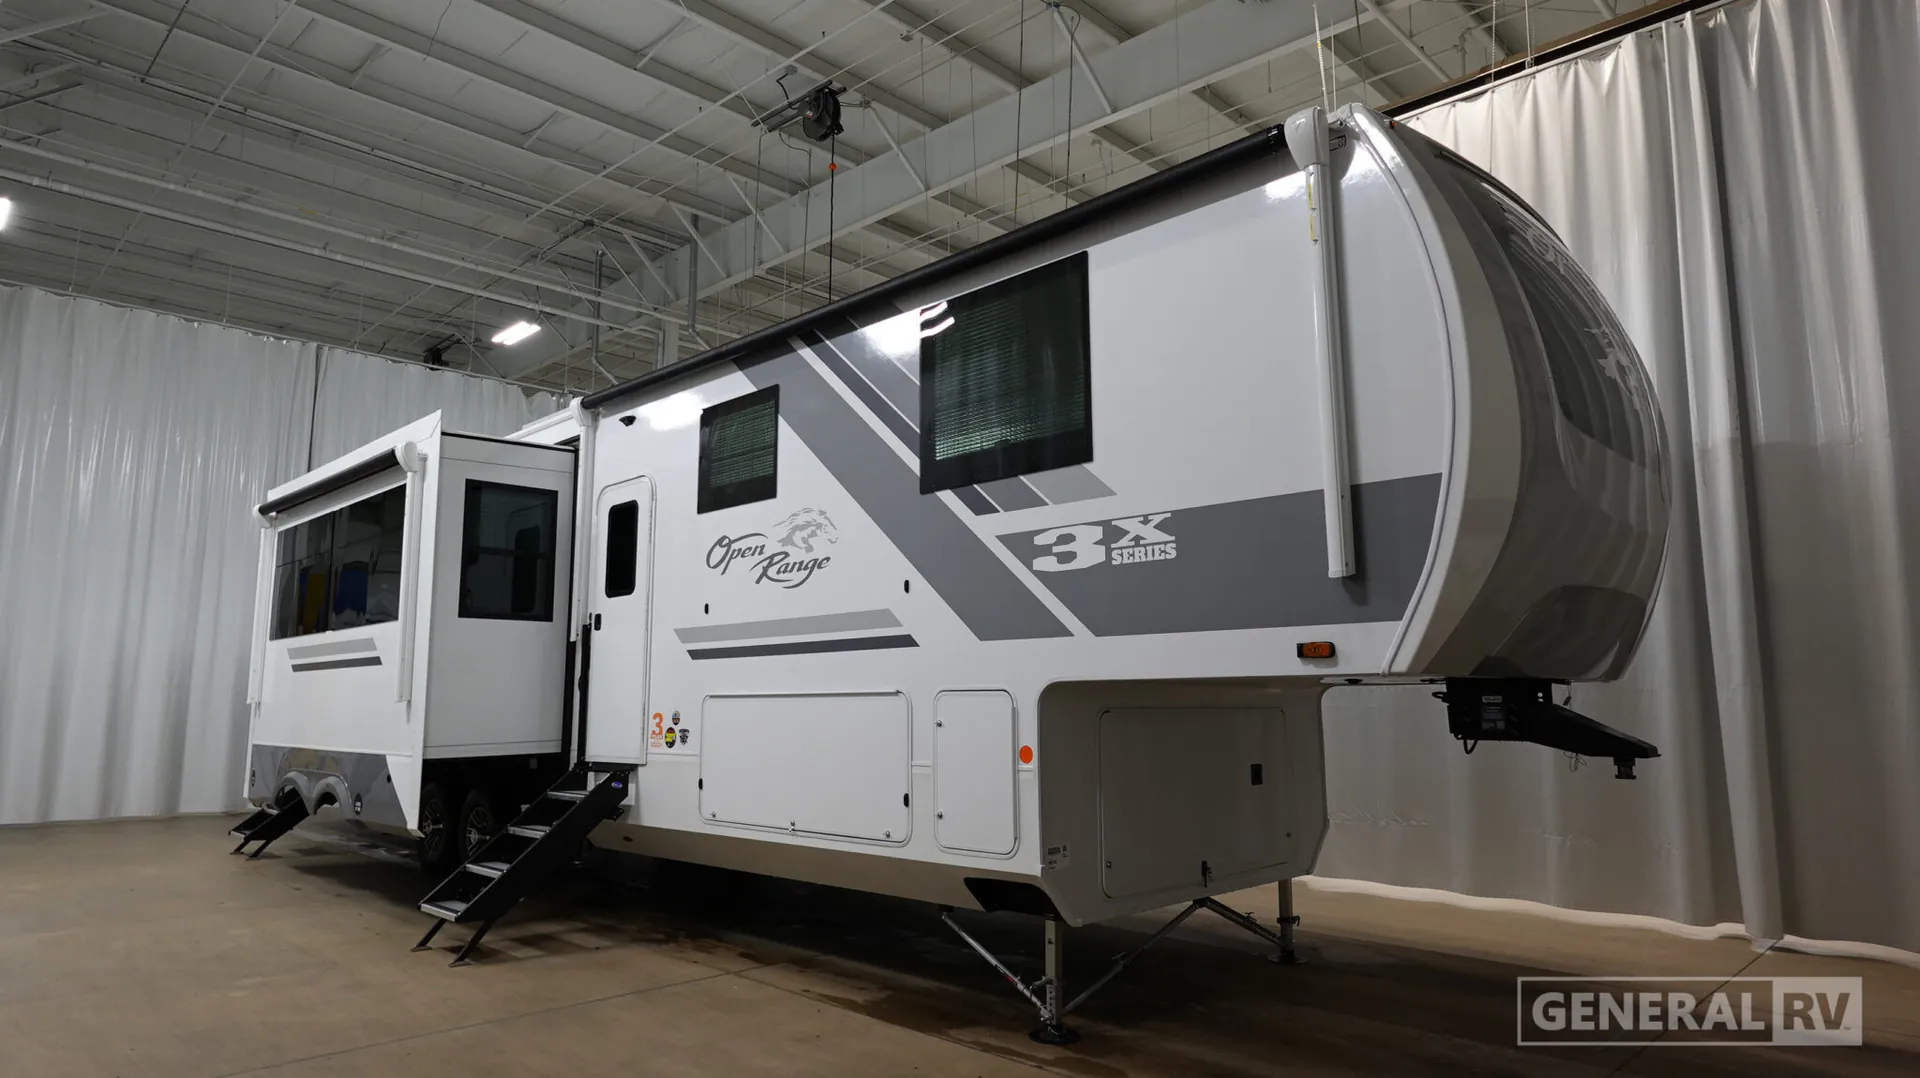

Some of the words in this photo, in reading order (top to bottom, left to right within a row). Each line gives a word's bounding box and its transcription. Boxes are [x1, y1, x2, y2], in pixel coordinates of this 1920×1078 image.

[706, 532, 769, 576] Open
[1111, 543, 1177, 565] SERIES
[749, 551, 831, 590] Range
[651, 712, 664, 736] 3
